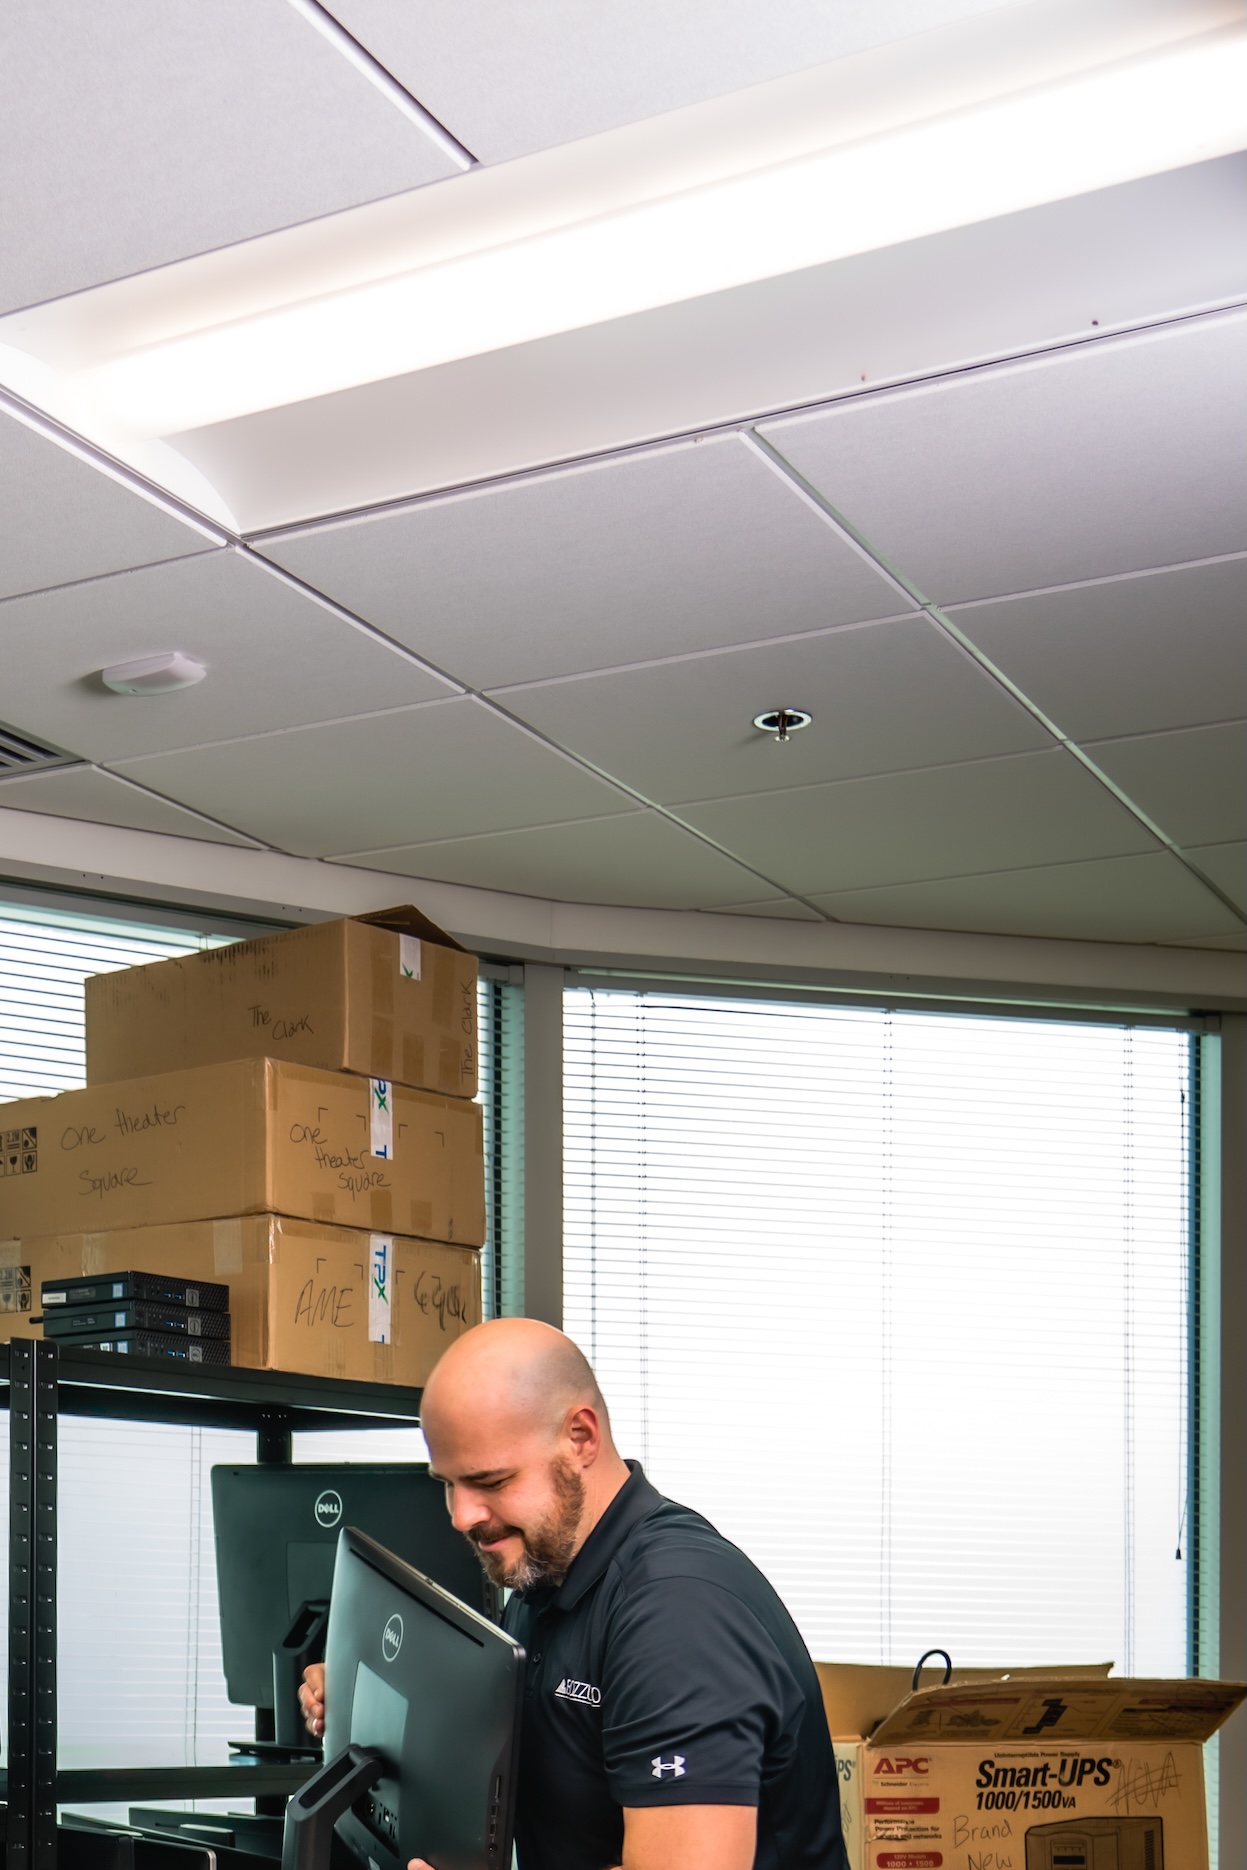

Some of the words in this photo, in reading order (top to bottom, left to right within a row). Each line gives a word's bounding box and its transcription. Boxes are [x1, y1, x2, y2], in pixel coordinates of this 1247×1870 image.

[247, 1005, 272, 1028] The
[460, 979, 474, 1035] Clark
[272, 1015, 315, 1041] Clark
[461, 1047, 474, 1084] The
[61, 1126, 106, 1151] One
[114, 1105, 186, 1137] theater
[290, 1124, 328, 1144] One
[78, 1167, 154, 1200] Square
[373, 1245, 390, 1306] TPX
[318, 1503, 340, 1515] DELL
[384, 1628, 401, 1650] DELL
[836, 1759, 852, 1781] PS
[873, 1757, 929, 1775] APC
[976, 1757, 1113, 1789] Smart-UPS
[976, 1790, 1076, 1812] 1000/1500VA
[953, 1814, 1013, 1849] Brand
